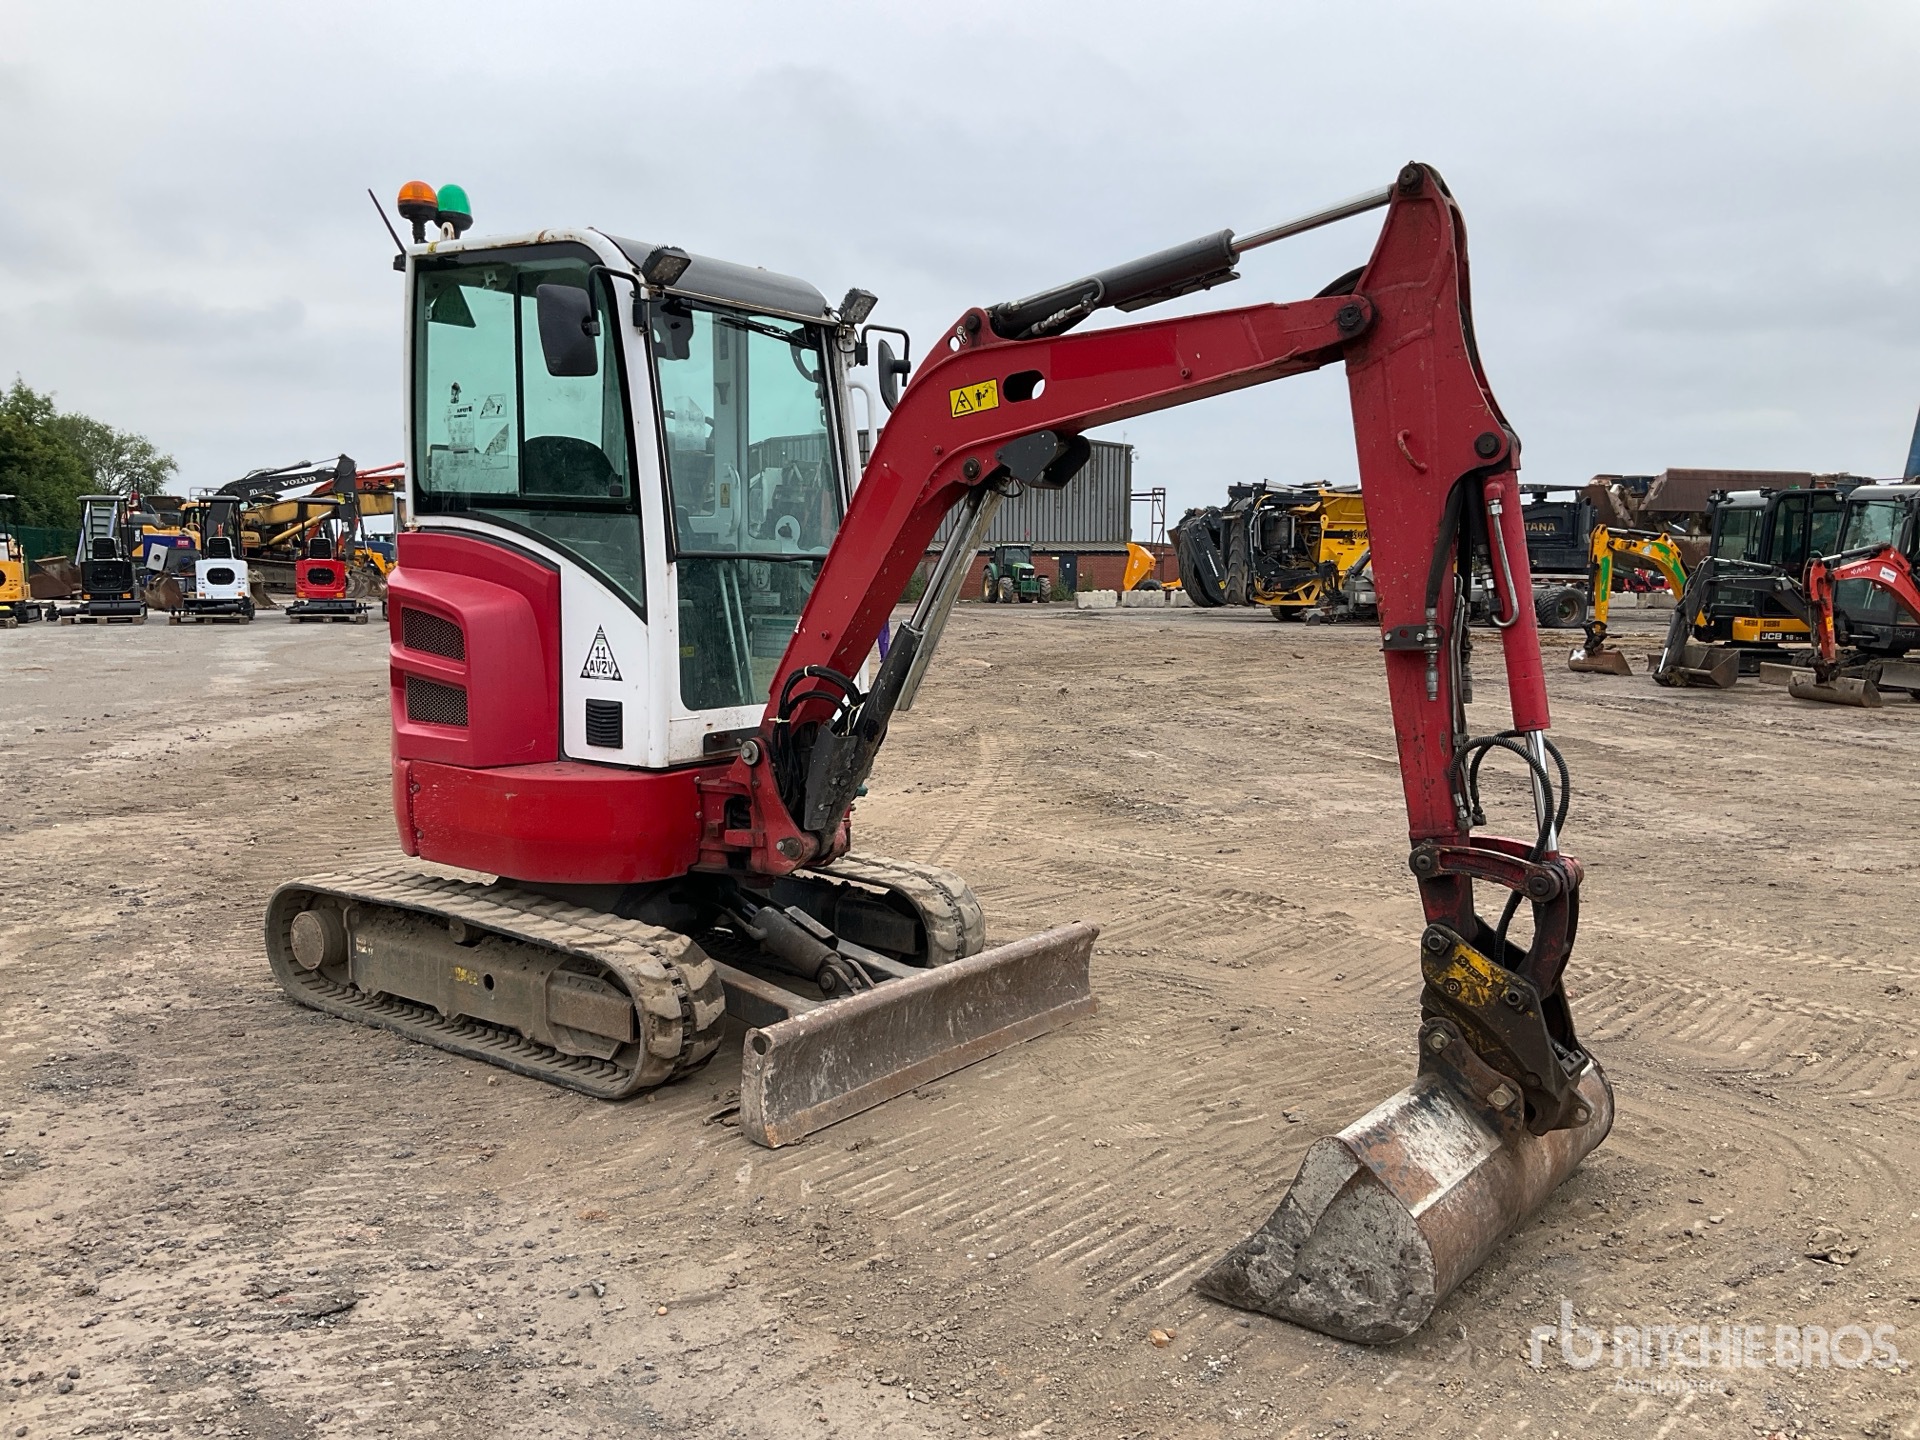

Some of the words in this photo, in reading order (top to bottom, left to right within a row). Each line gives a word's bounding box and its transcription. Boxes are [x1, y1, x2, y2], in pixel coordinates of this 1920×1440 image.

[280, 476, 316, 487] VOLVO
[1525, 522, 1556, 531] TANA
[1761, 632, 1782, 640] JCB
[595, 646, 606, 659] 11
[590, 660, 613, 673] AV2V
